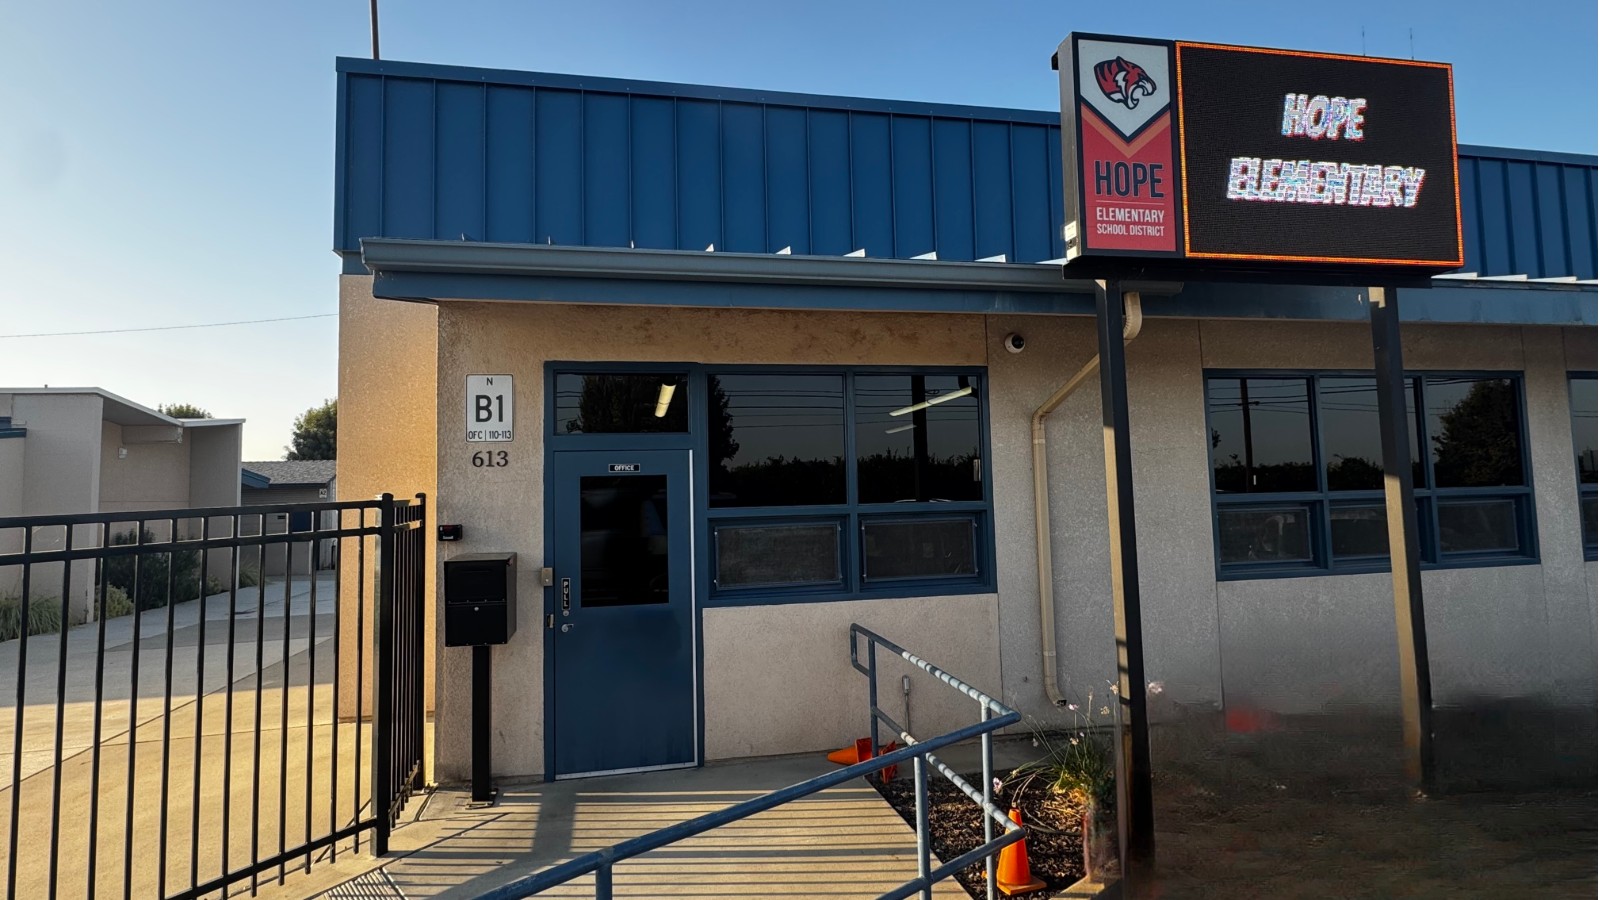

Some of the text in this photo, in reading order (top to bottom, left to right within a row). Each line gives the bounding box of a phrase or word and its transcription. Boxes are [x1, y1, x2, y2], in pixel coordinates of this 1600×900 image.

[1281, 93, 1367, 142] HOPE
[1094, 160, 1164, 198] HOPE
[1227, 157, 1425, 208] ELEMENTARY
[1096, 207, 1164, 223] ELEMENTARY
[1097, 223, 1165, 237] SCHOOL DISTRICT
[486, 377, 493, 386] N
[475, 394, 503, 422] B1
[468, 430, 511, 439] OFC 110-113
[472, 450, 508, 467] 613
